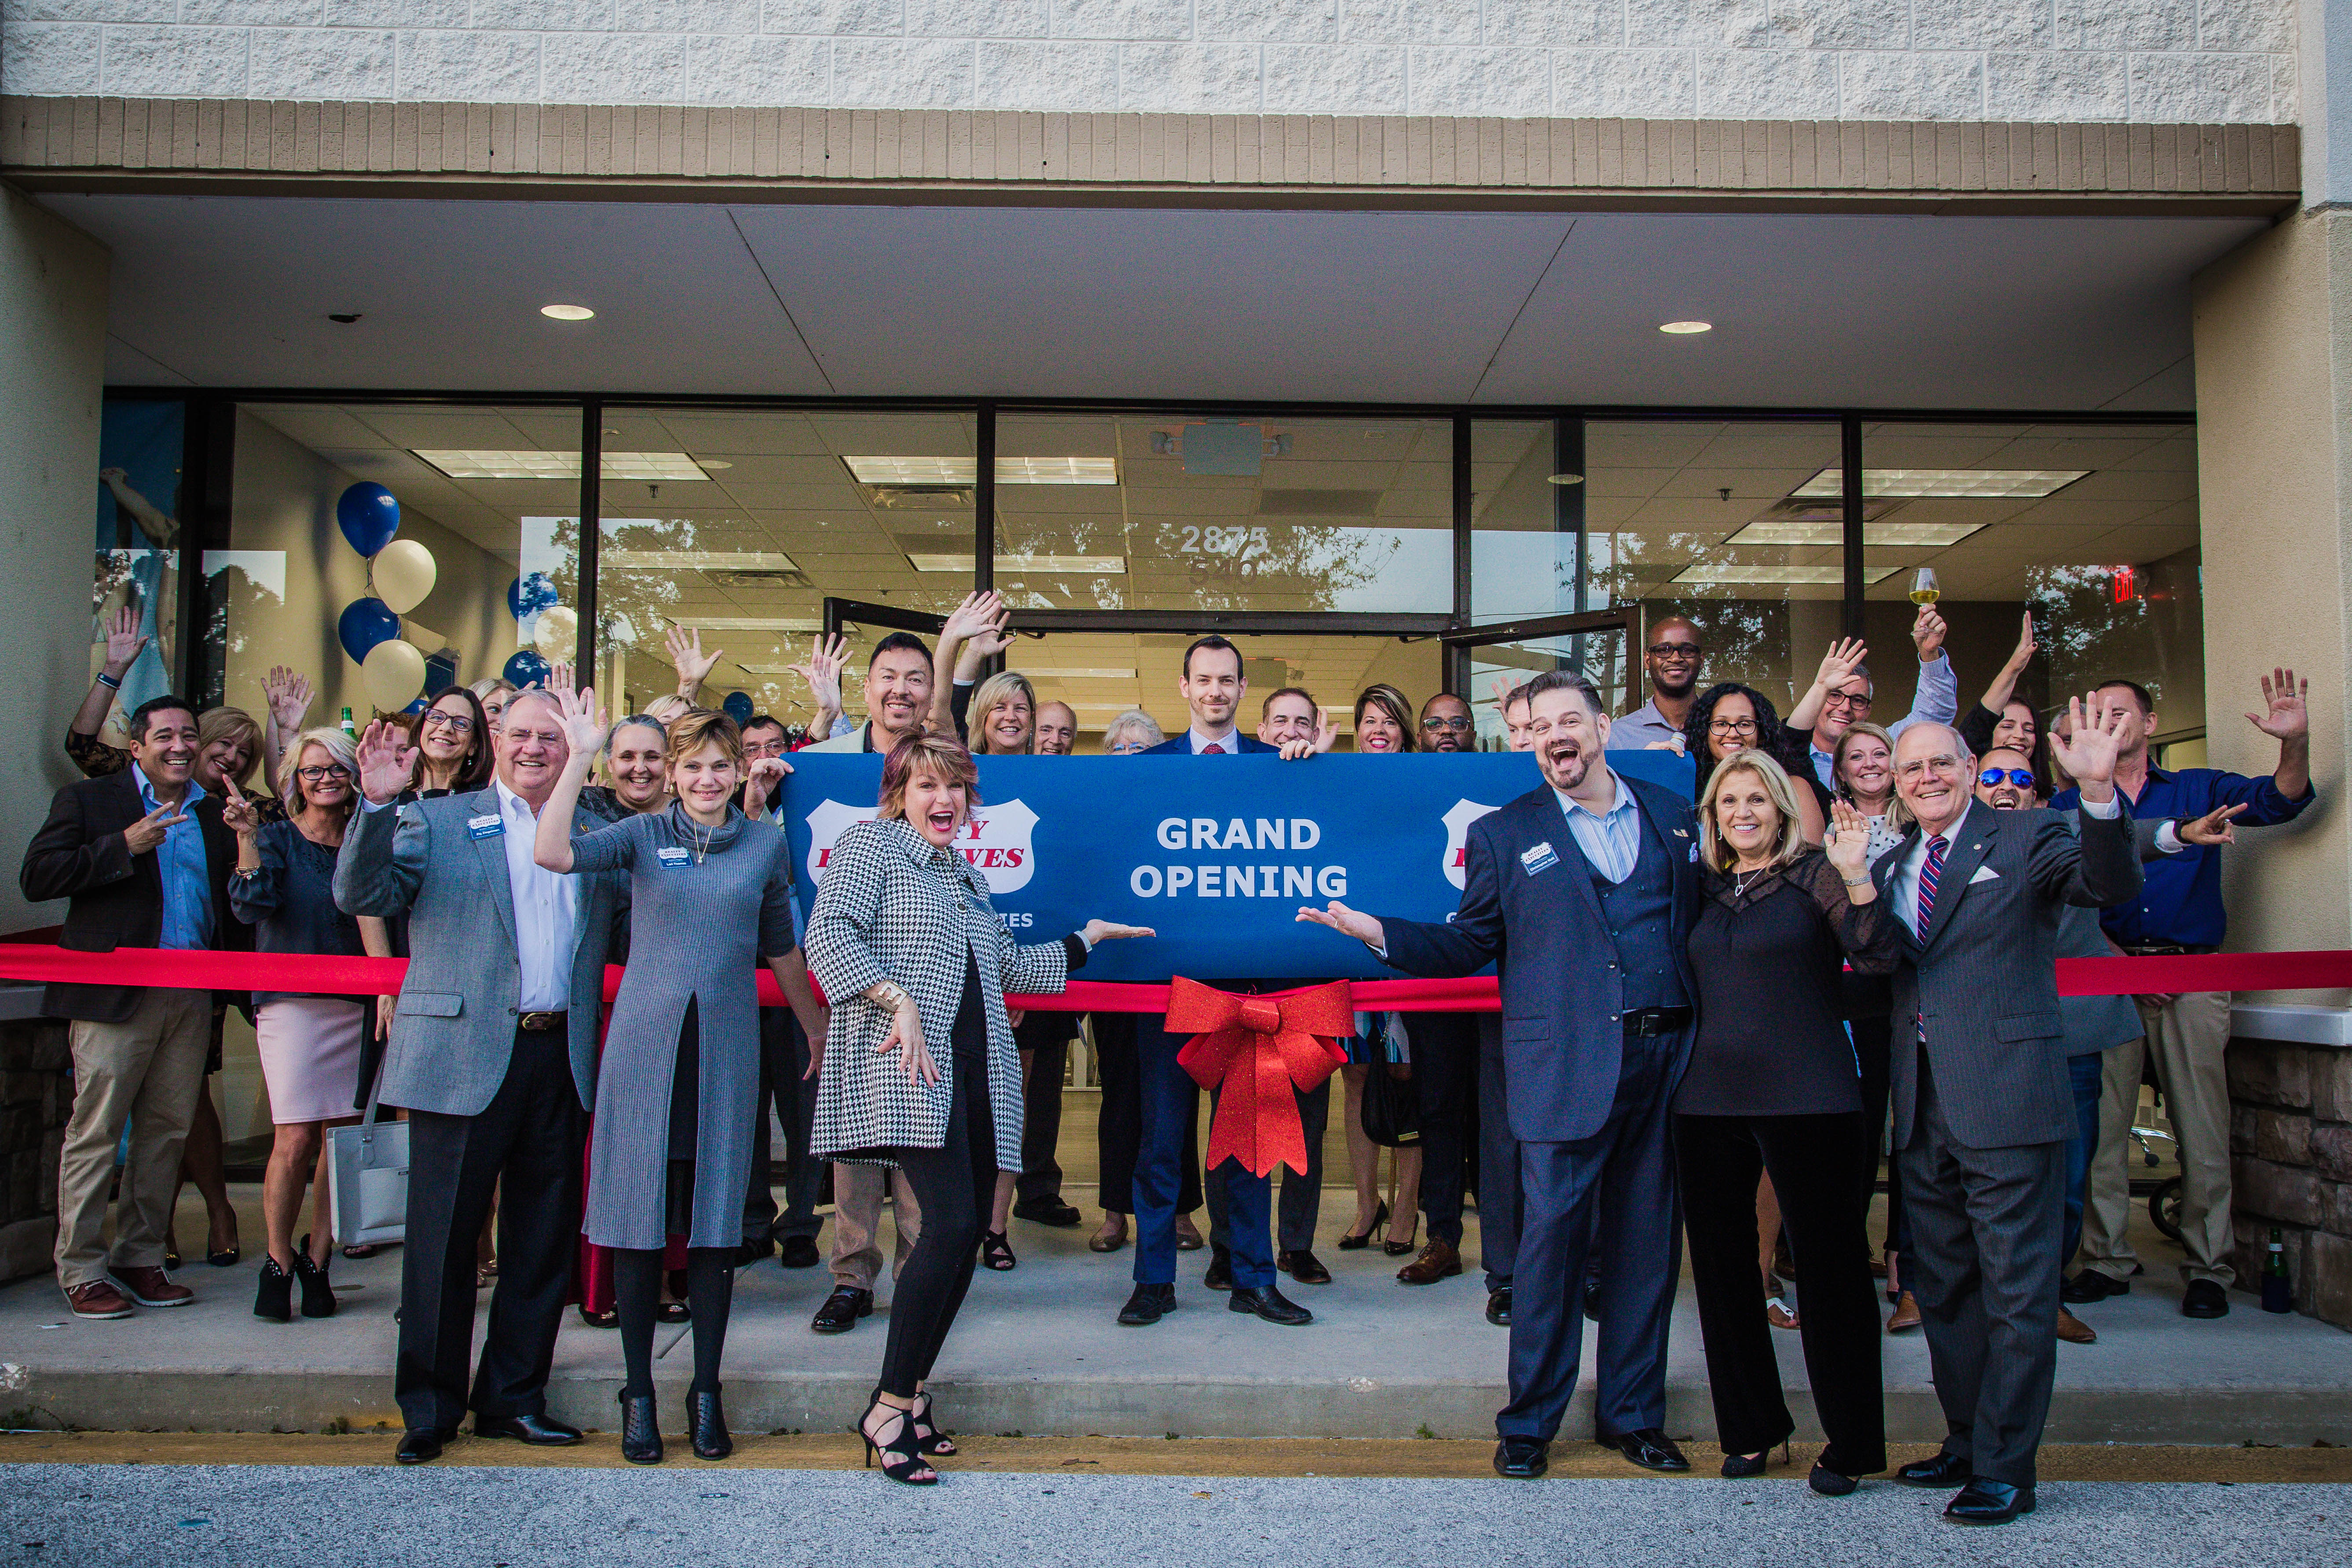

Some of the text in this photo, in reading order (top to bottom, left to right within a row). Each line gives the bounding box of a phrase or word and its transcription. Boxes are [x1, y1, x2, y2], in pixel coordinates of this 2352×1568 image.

[1181, 525, 1268, 555] 2875
[2115, 568, 2134, 603] EXIT
[1157, 817, 1320, 850] GRAND
[1528, 848, 1542, 857] REALTY
[1130, 865, 1347, 898] OPENING
